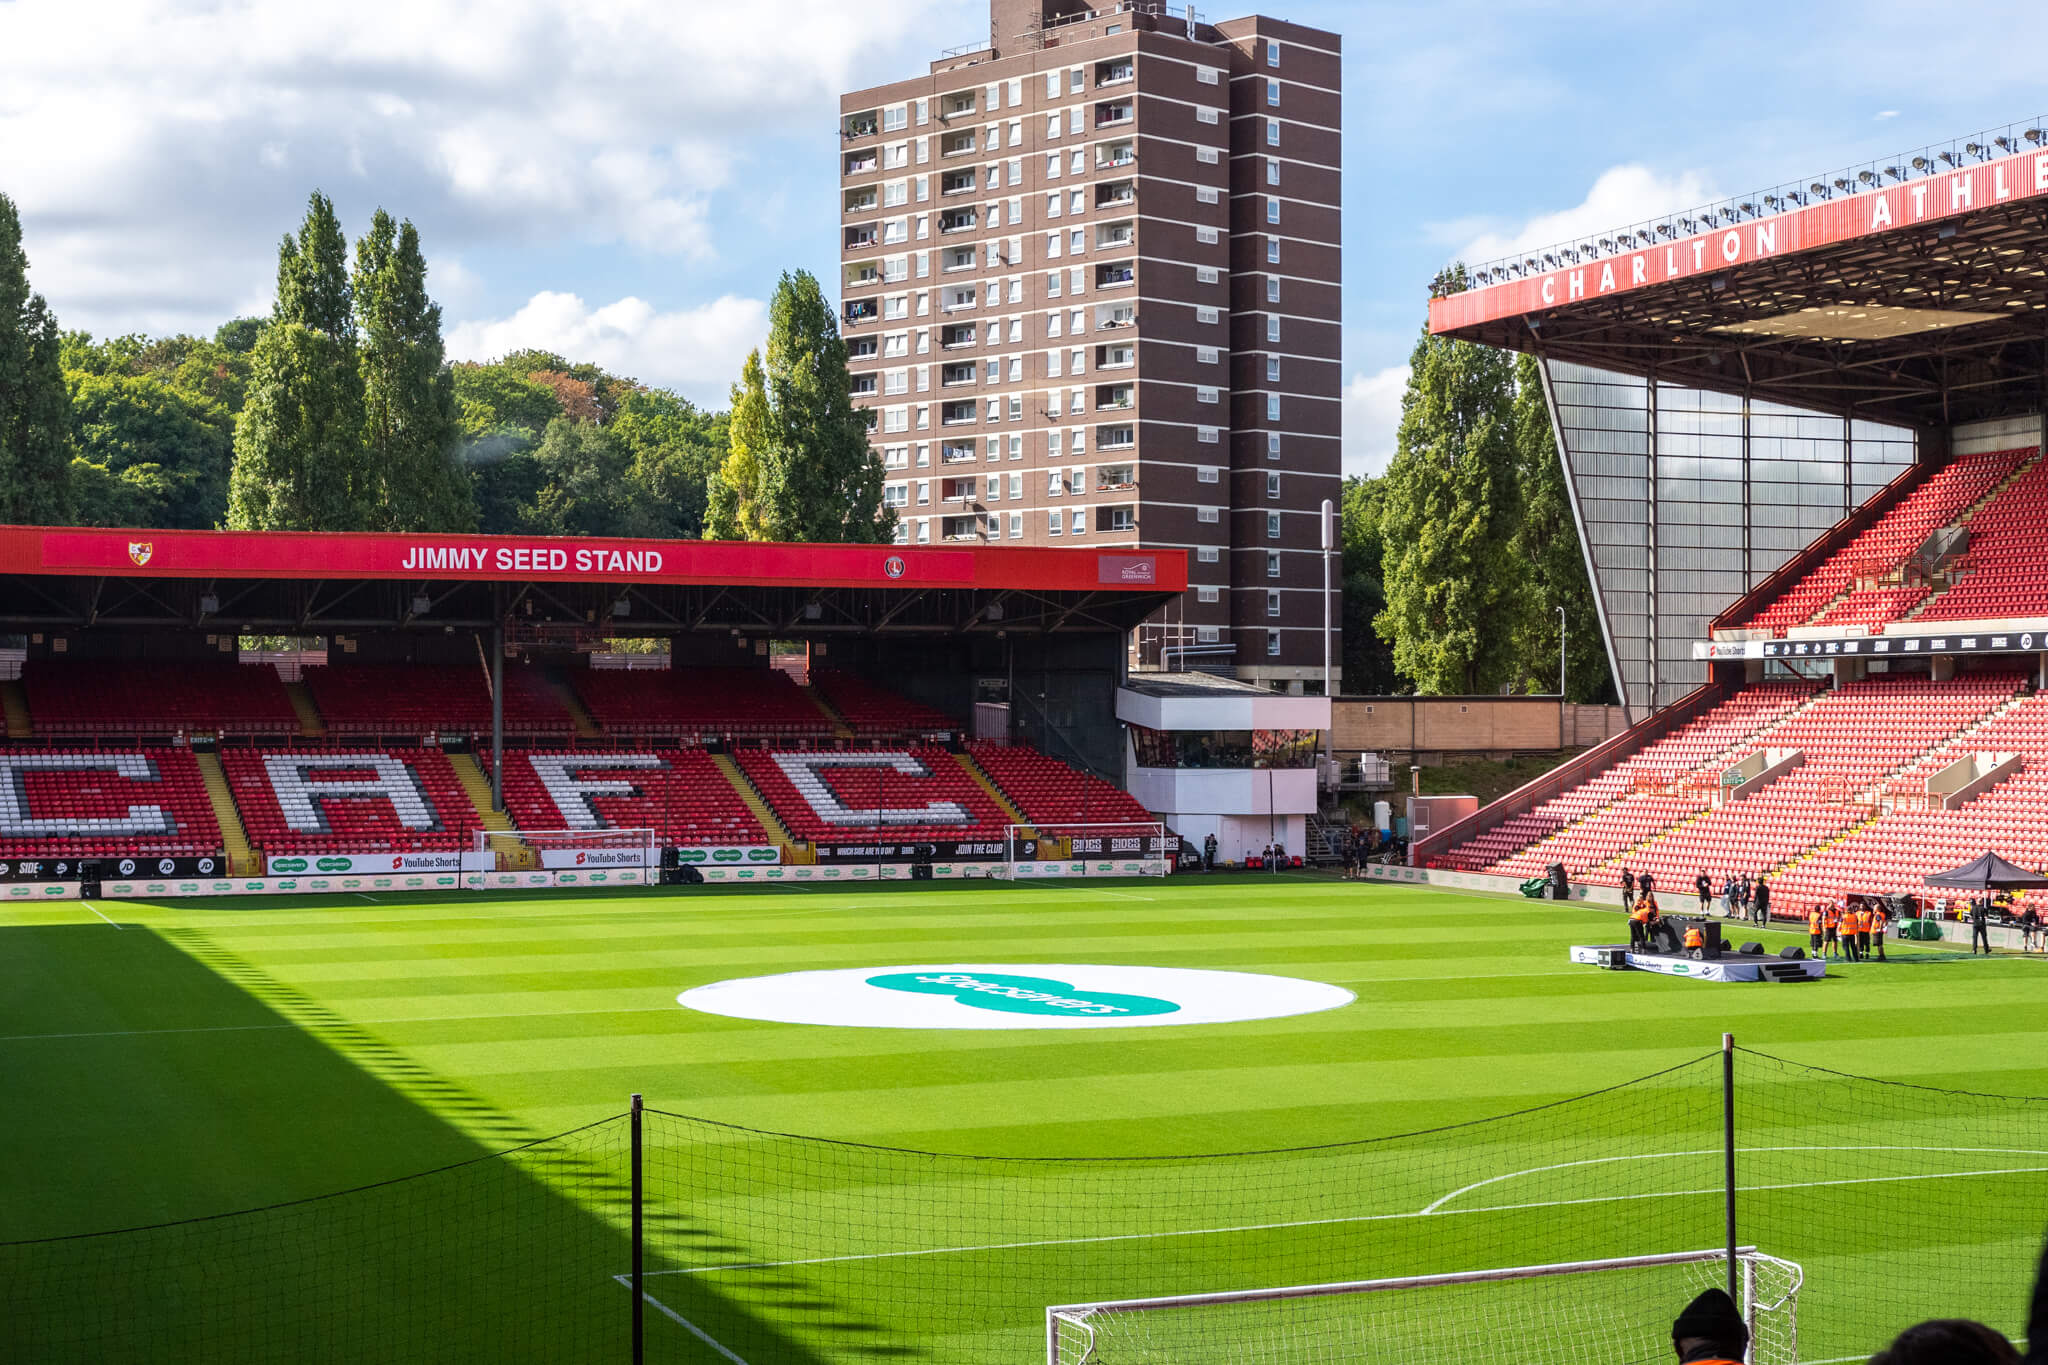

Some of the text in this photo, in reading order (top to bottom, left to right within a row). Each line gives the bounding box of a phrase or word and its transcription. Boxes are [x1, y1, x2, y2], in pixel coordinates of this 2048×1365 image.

[1542, 222, 1776, 304] CHARLTON
[402, 547, 662, 572] JIMMY SEED STAND
[586, 853, 640, 863] YouTube Shorts
[955, 843, 1003, 855] JOIN THE CLUB
[404, 857, 460, 867] YouTube Shorts
[915, 974, 1130, 1014] Specsavers
